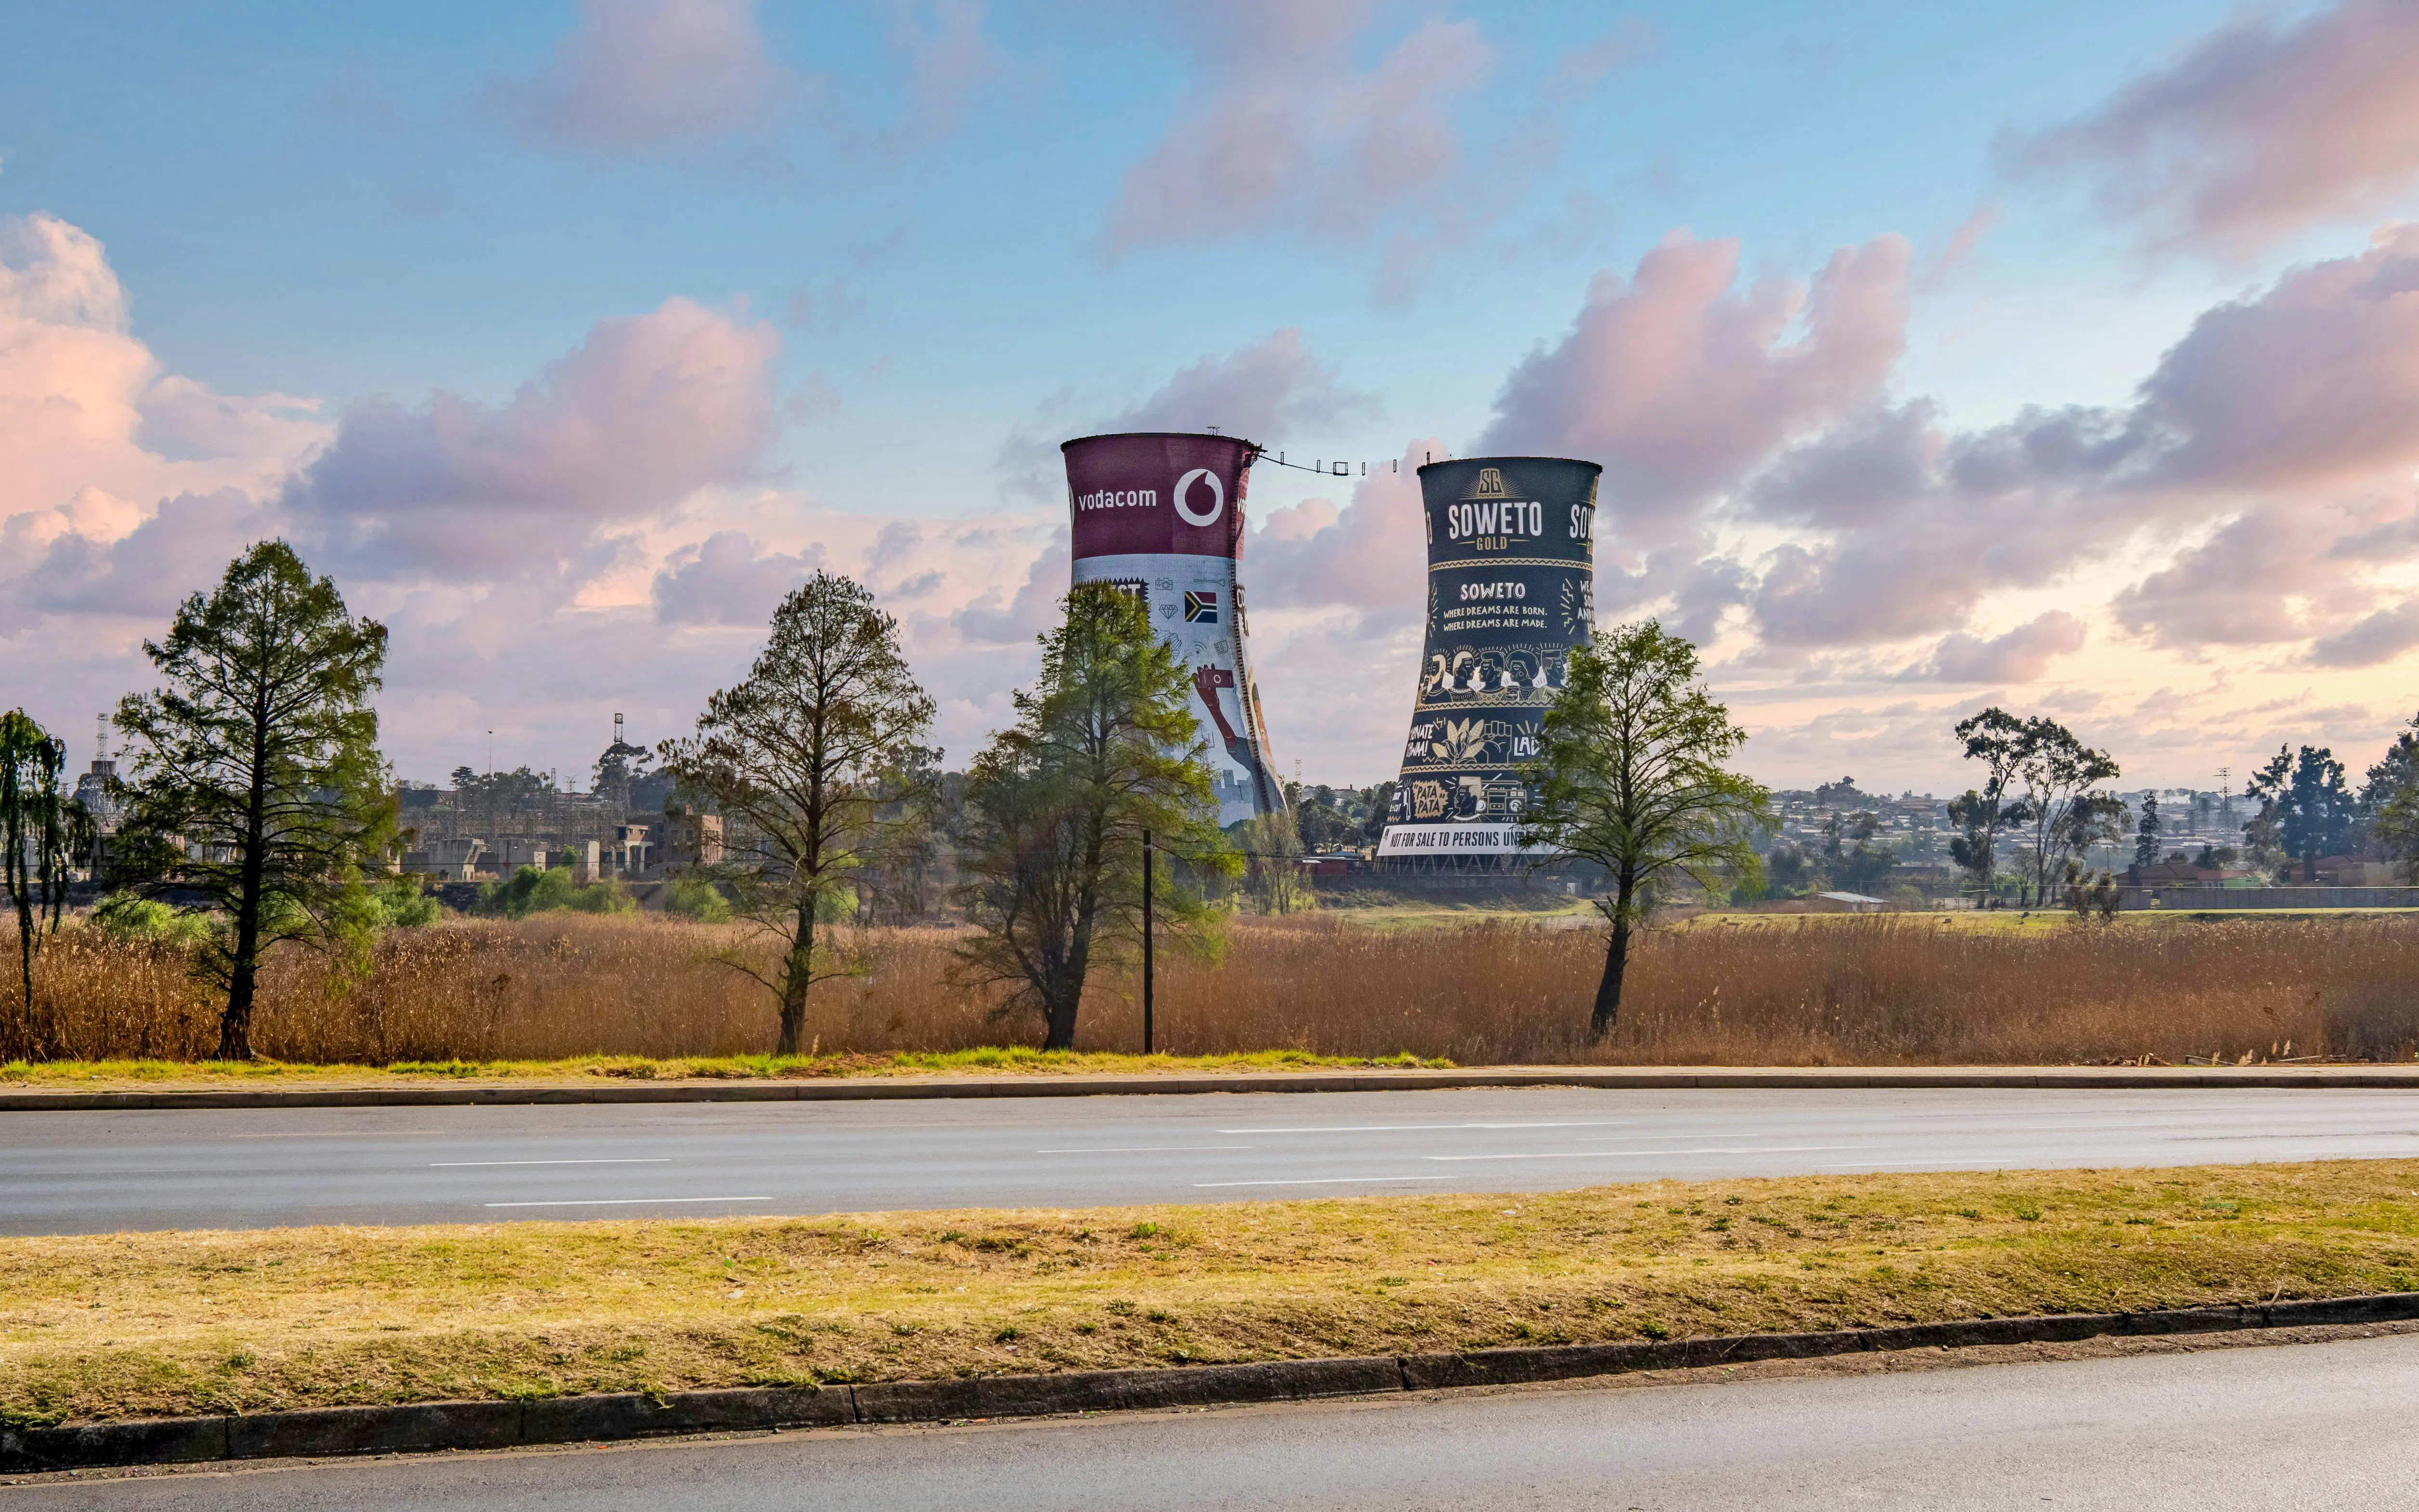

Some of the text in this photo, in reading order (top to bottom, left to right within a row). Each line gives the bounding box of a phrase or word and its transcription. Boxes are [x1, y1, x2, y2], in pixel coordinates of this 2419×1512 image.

[1078, 489, 1156, 511] vodacom
[1448, 501, 1542, 539] SOWETO
[1476, 536, 1508, 551] GOLD
[1460, 582, 1525, 602] SOWETO
[1444, 605, 1548, 619] WHERE DREAMS ARE BORN.
[1444, 618, 1547, 632] WHERE DREAMS ARE MADE.
[1390, 833, 1402, 847] NOT
[1401, 832, 1415, 847] FOR
[1416, 832, 1437, 847] SALE
[1439, 832, 1450, 847] TO
[1452, 831, 1499, 847] PERSONS
